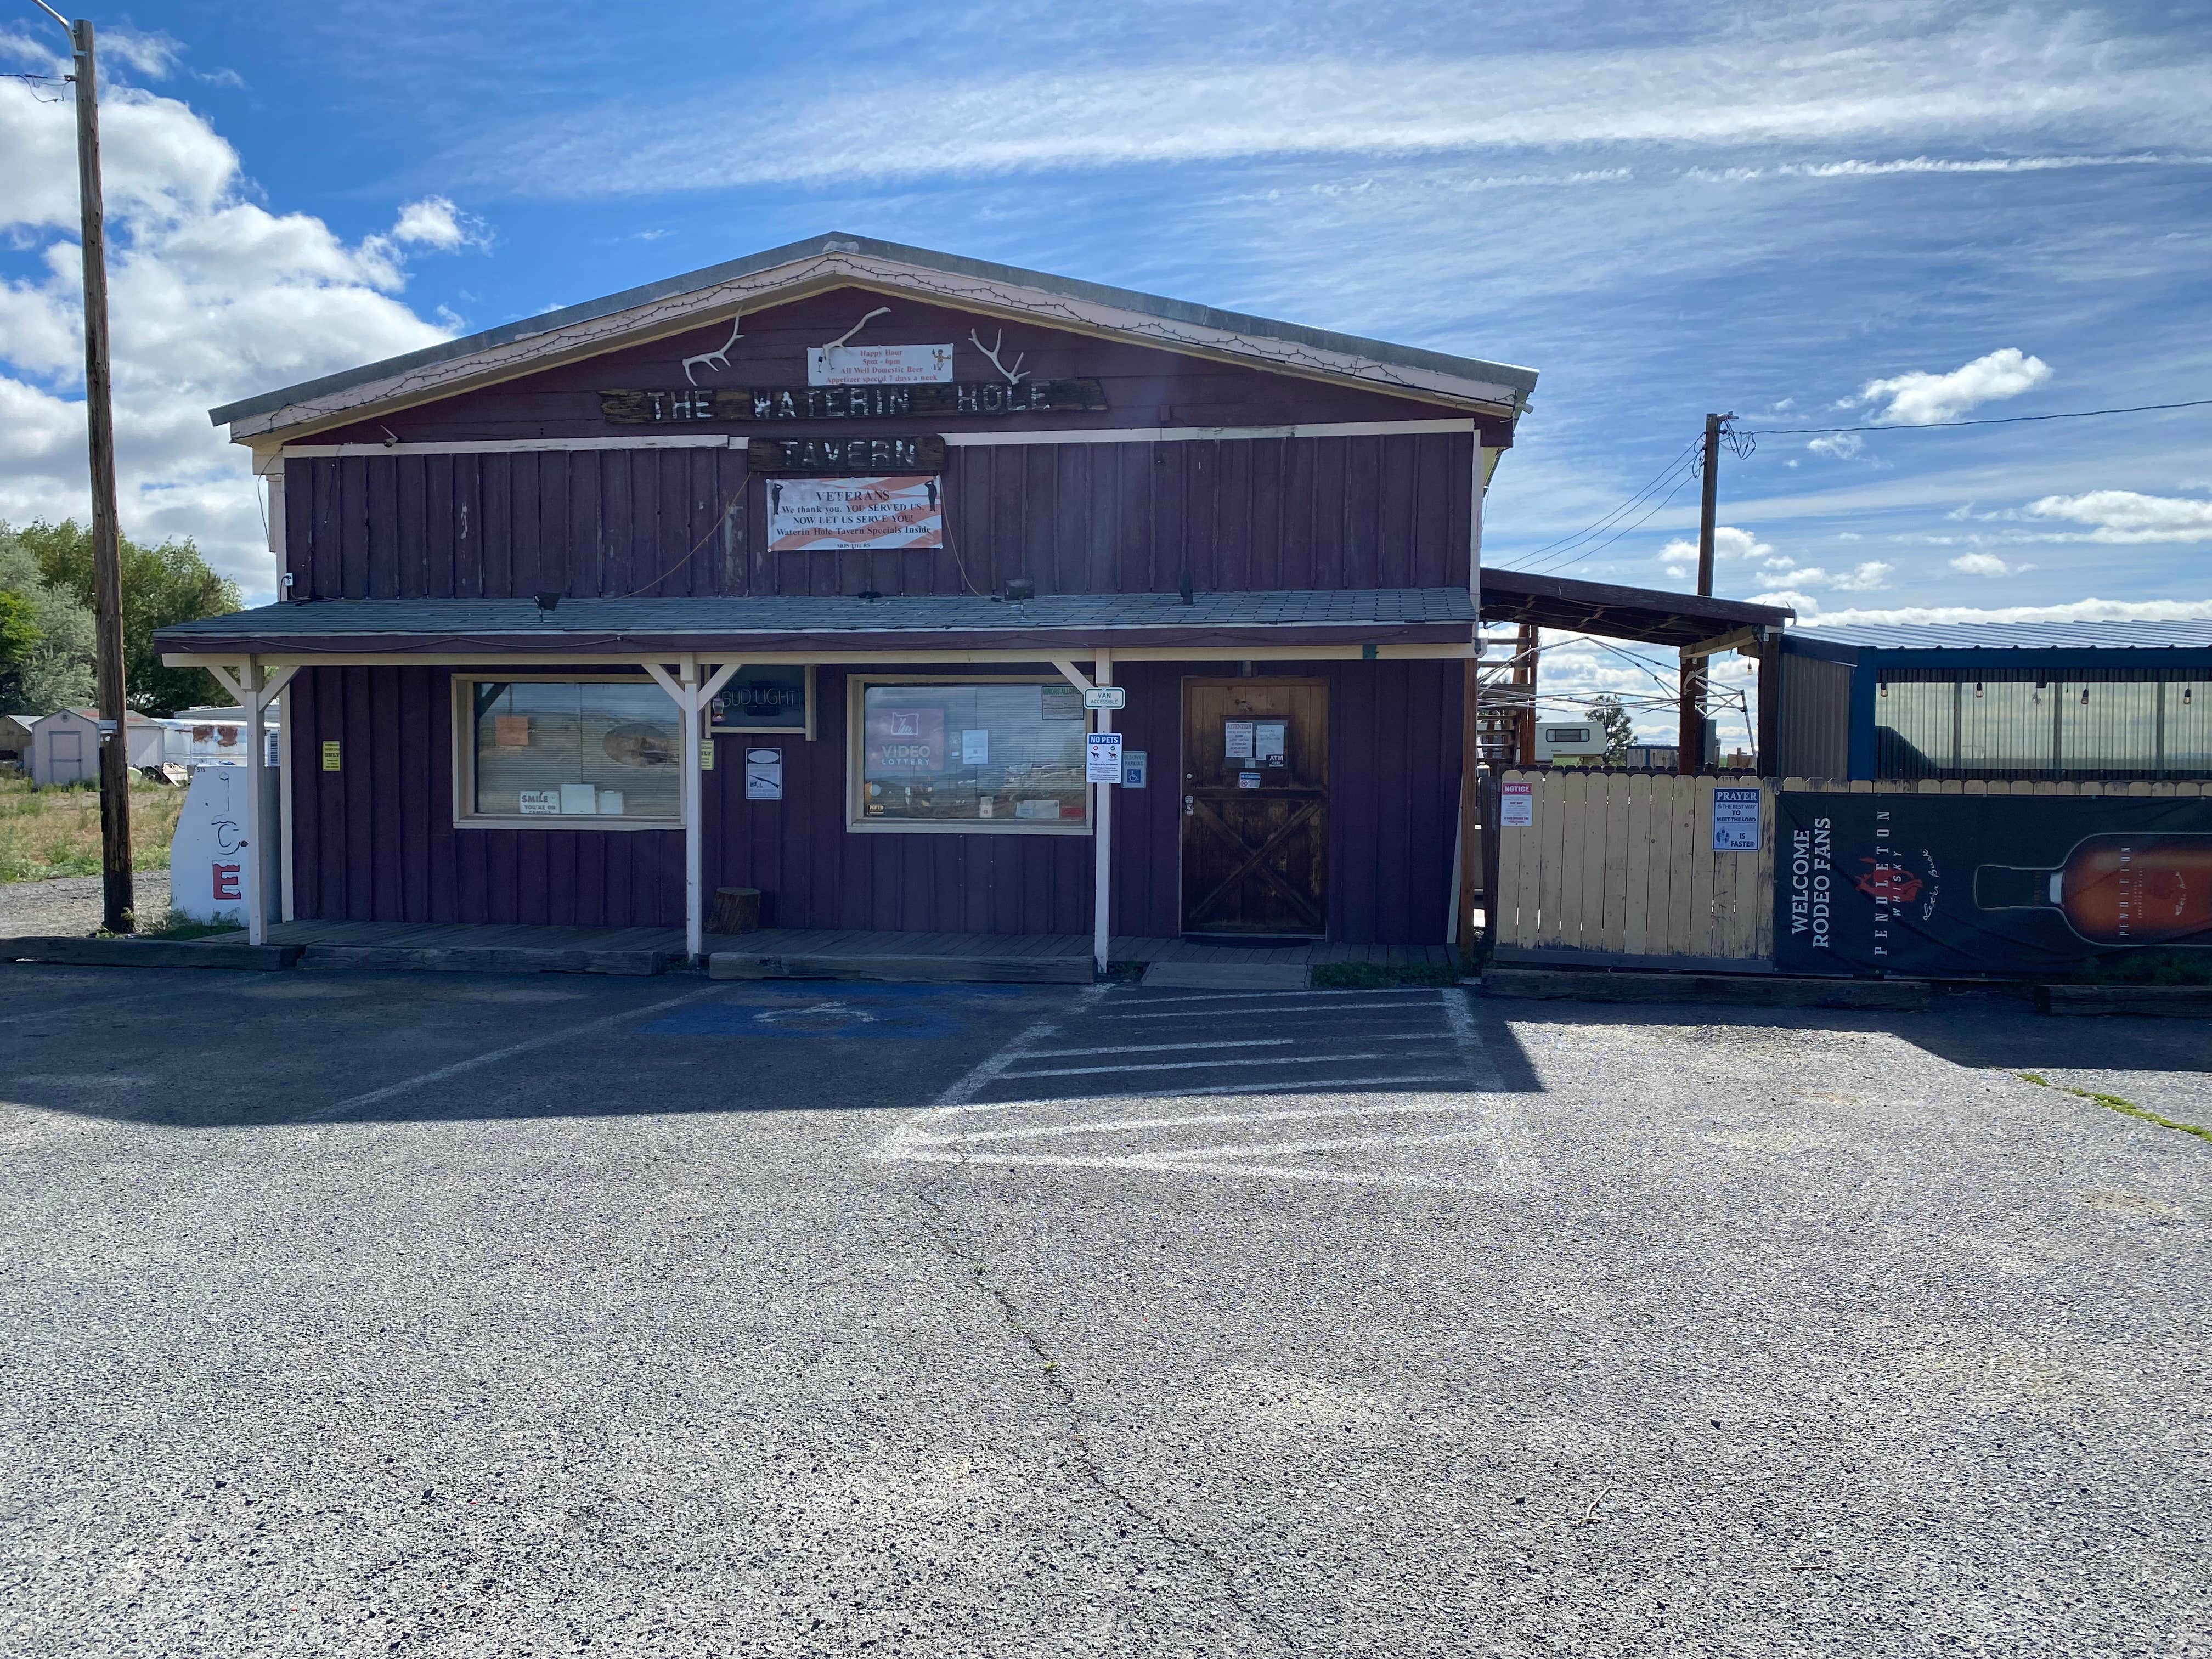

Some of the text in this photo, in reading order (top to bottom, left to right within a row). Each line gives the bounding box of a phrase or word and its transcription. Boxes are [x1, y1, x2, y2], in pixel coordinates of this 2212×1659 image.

[647, 382, 1051, 420] THE WATERIN HOLE
[780, 439, 915, 466] TAVERN
[816, 490, 890, 501] VETERANS
[842, 516, 853, 524] US
[856, 515, 888, 523] SERVE
[892, 515, 913, 523] YOU!
[868, 504, 906, 512] SERVED
[777, 528, 810, 536] Waterin
[836, 527, 864, 535] Tavern
[867, 526, 901, 536] Specials
[905, 525, 931, 534] Inside
[722, 688, 795, 707] BUD LIGHT
[882, 745, 931, 758] VIDEO
[1717, 791, 1758, 801] PRAYER
[1792, 830, 1810, 934] WELCOME
[1813, 817, 1831, 948] RODEO FANS
[1874, 811, 1890, 956] PENDLETON
[1893, 851, 1903, 916] WHISKY
[2119, 847, 2131, 936] PENDLETON
